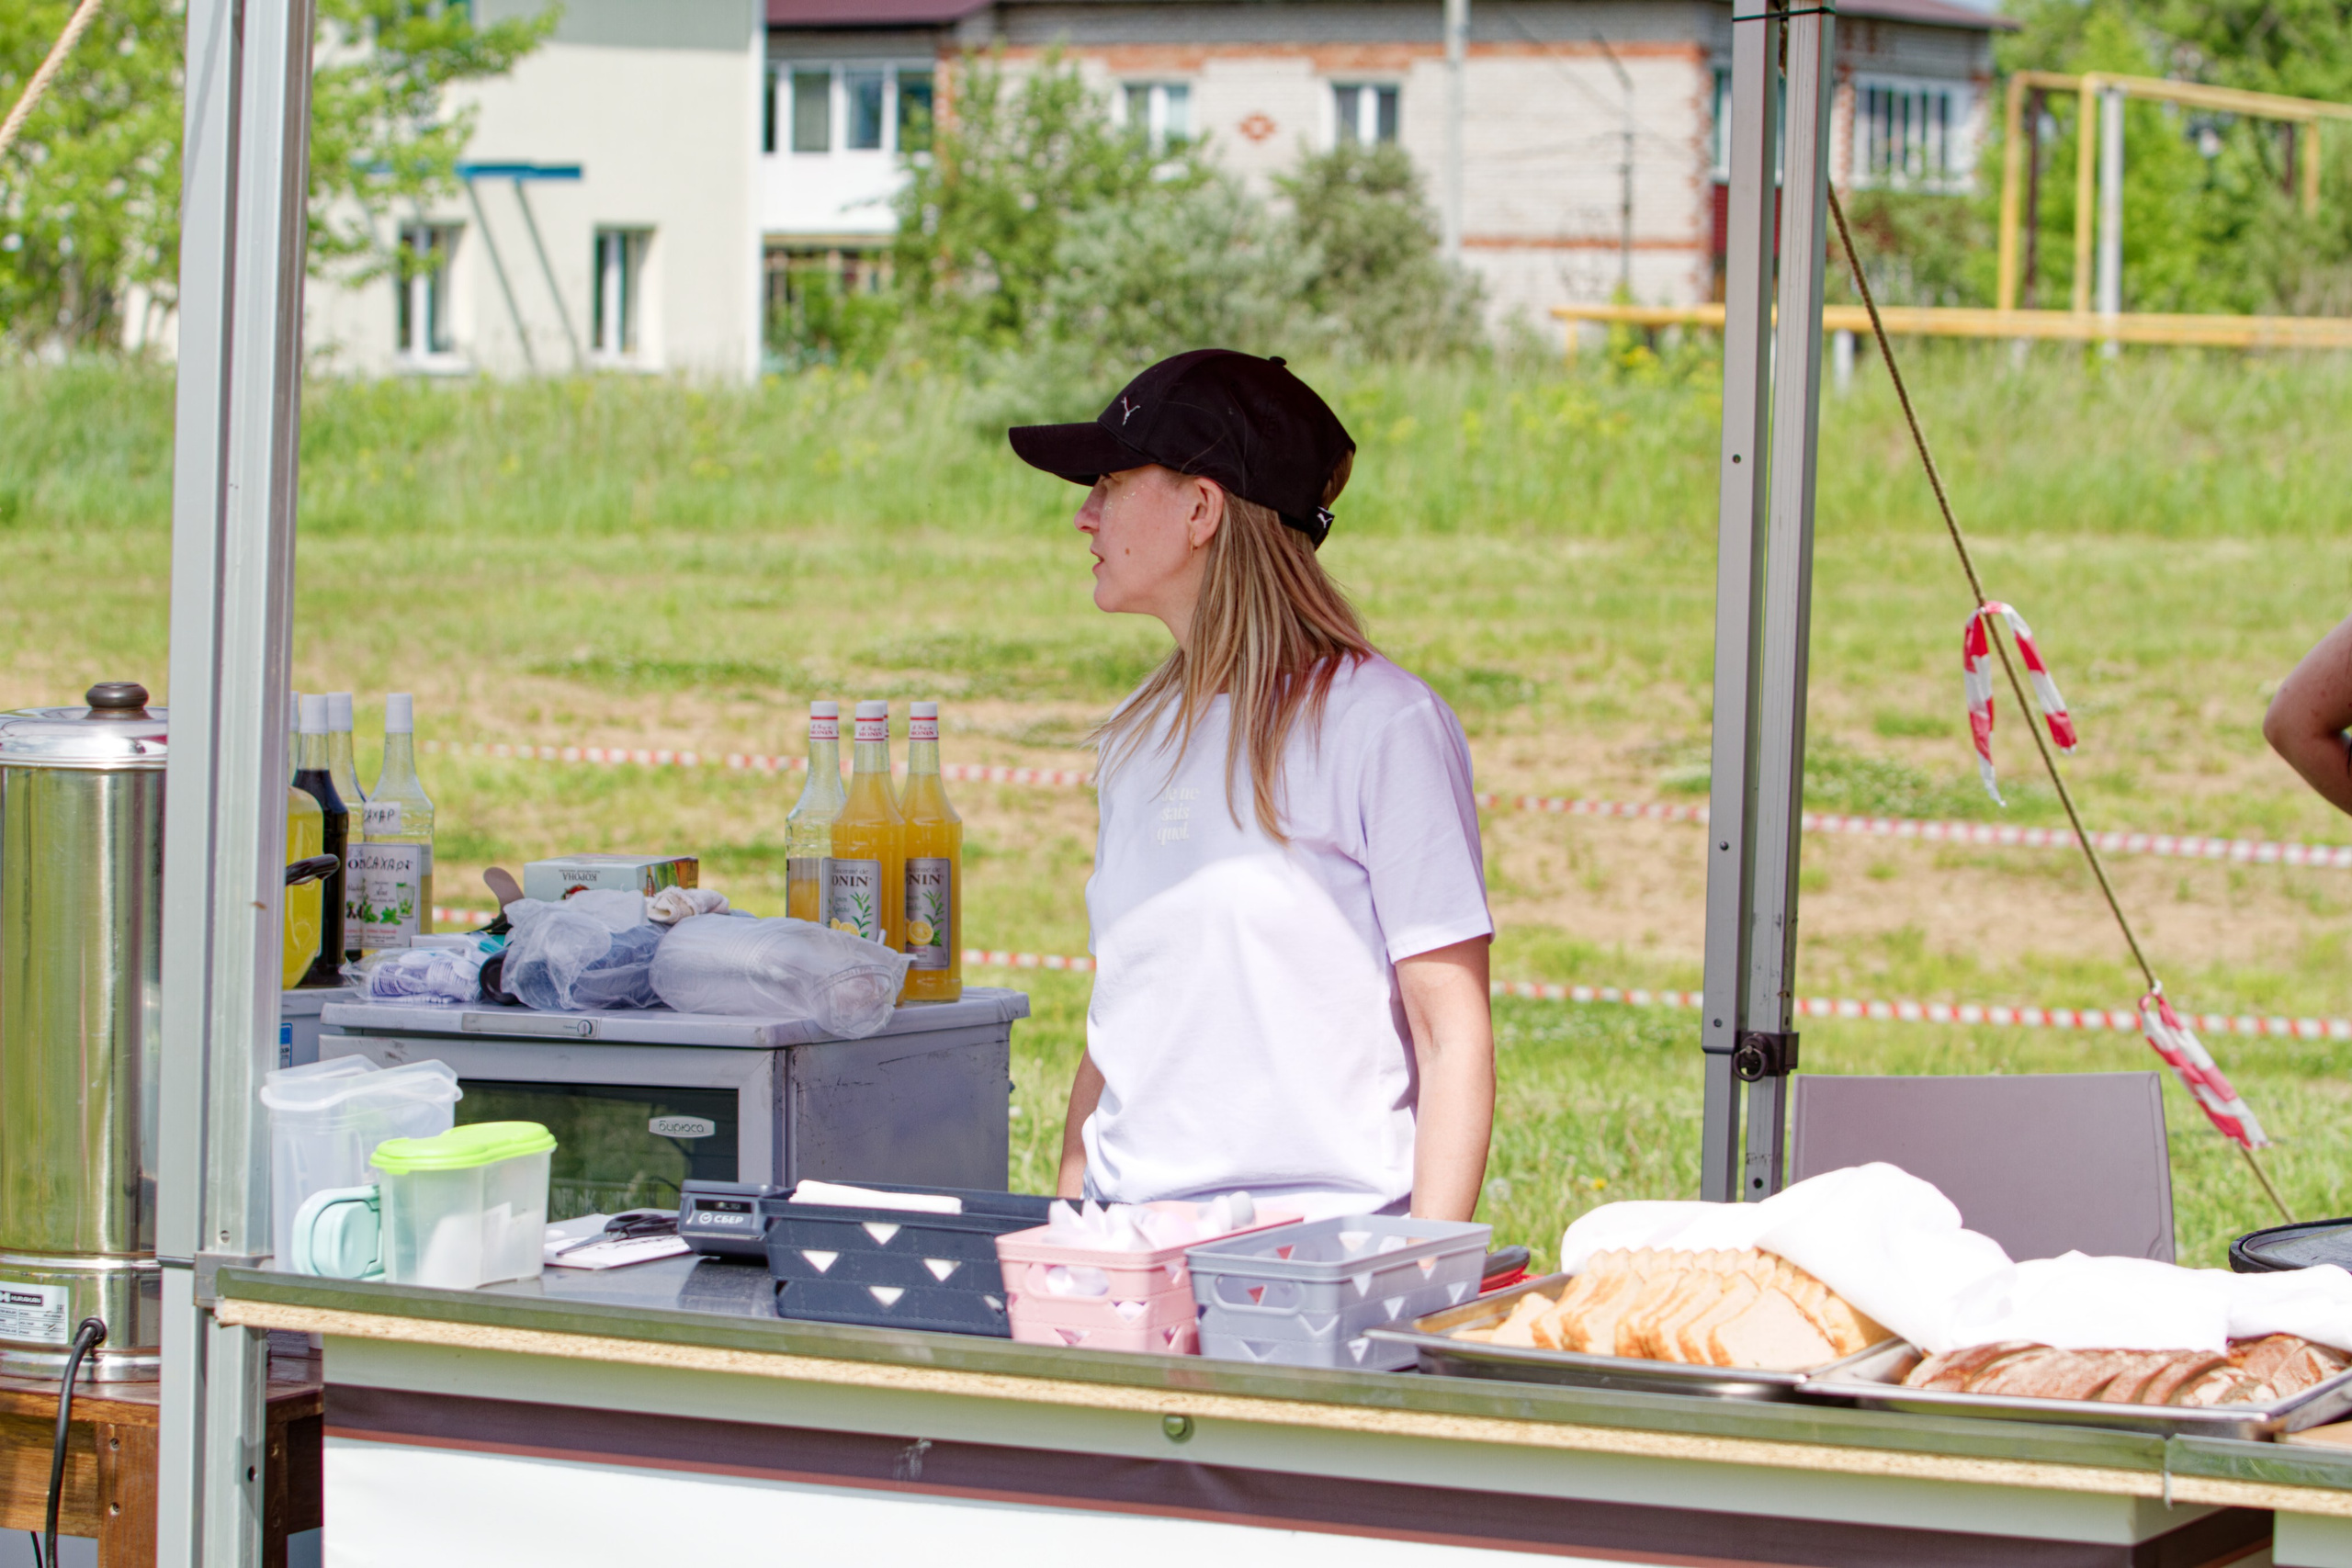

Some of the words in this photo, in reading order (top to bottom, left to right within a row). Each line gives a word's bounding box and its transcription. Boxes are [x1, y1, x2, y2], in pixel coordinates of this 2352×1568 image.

[1161, 784, 1177, 802] Je
[1180, 787, 1200, 800] ne
[1161, 803, 1191, 821] sais
[562, 872, 597, 881] КОРОНА
[831, 872, 868, 886] ONIN
[907, 874, 941, 886] NIN
[659, 1120, 705, 1134] бирюса
[713, 1214, 744, 1224] СБЕР
[10, 1295, 42, 1303] HURAKAN
